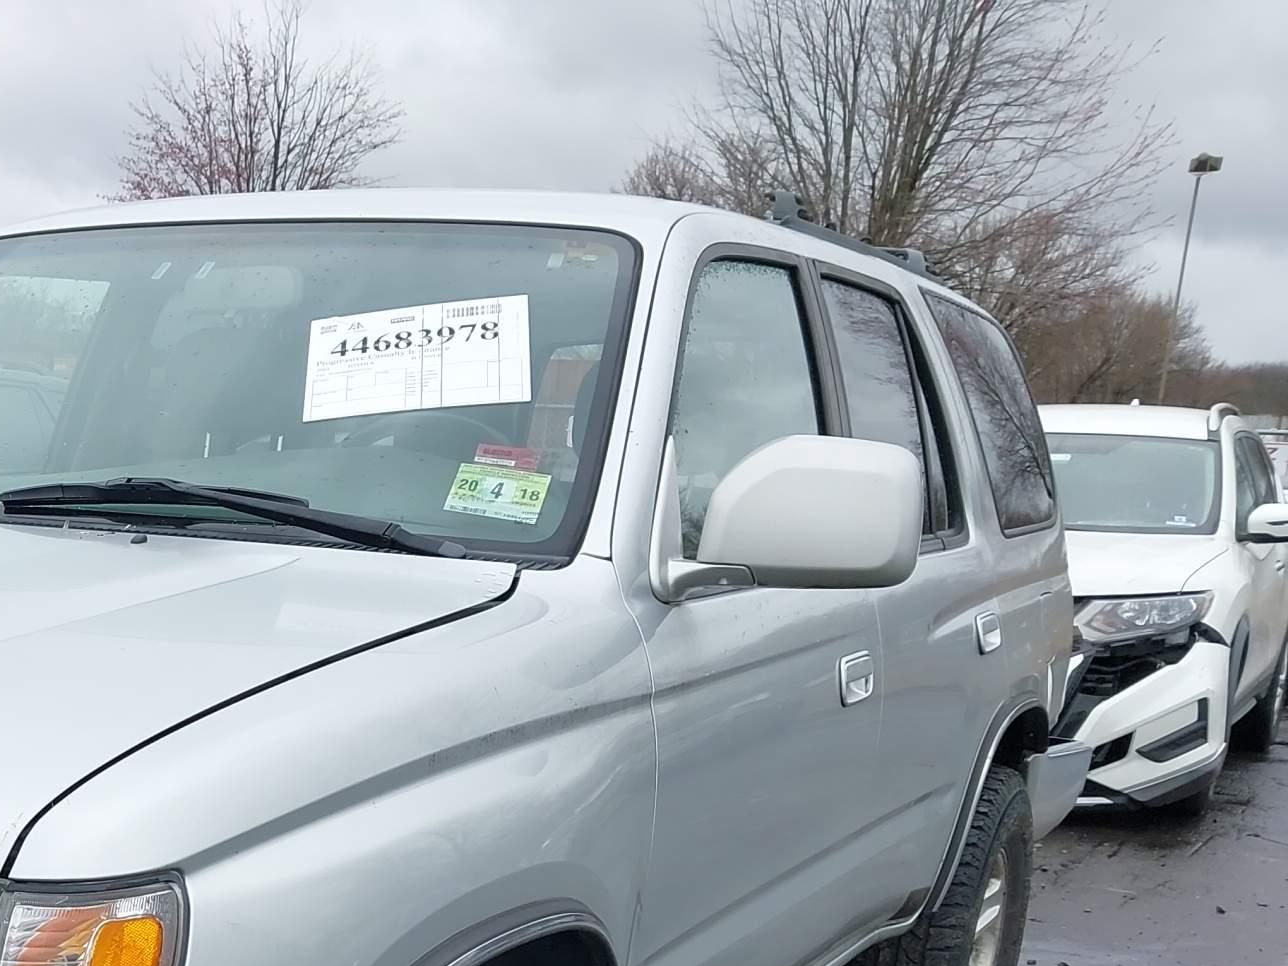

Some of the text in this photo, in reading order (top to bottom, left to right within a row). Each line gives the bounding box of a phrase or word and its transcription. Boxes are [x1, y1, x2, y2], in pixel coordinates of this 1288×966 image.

[330, 321, 499, 356] 44683978
[457, 478, 479, 492] 20
[490, 482, 505, 500] 4
[520, 488, 540, 501] 18
